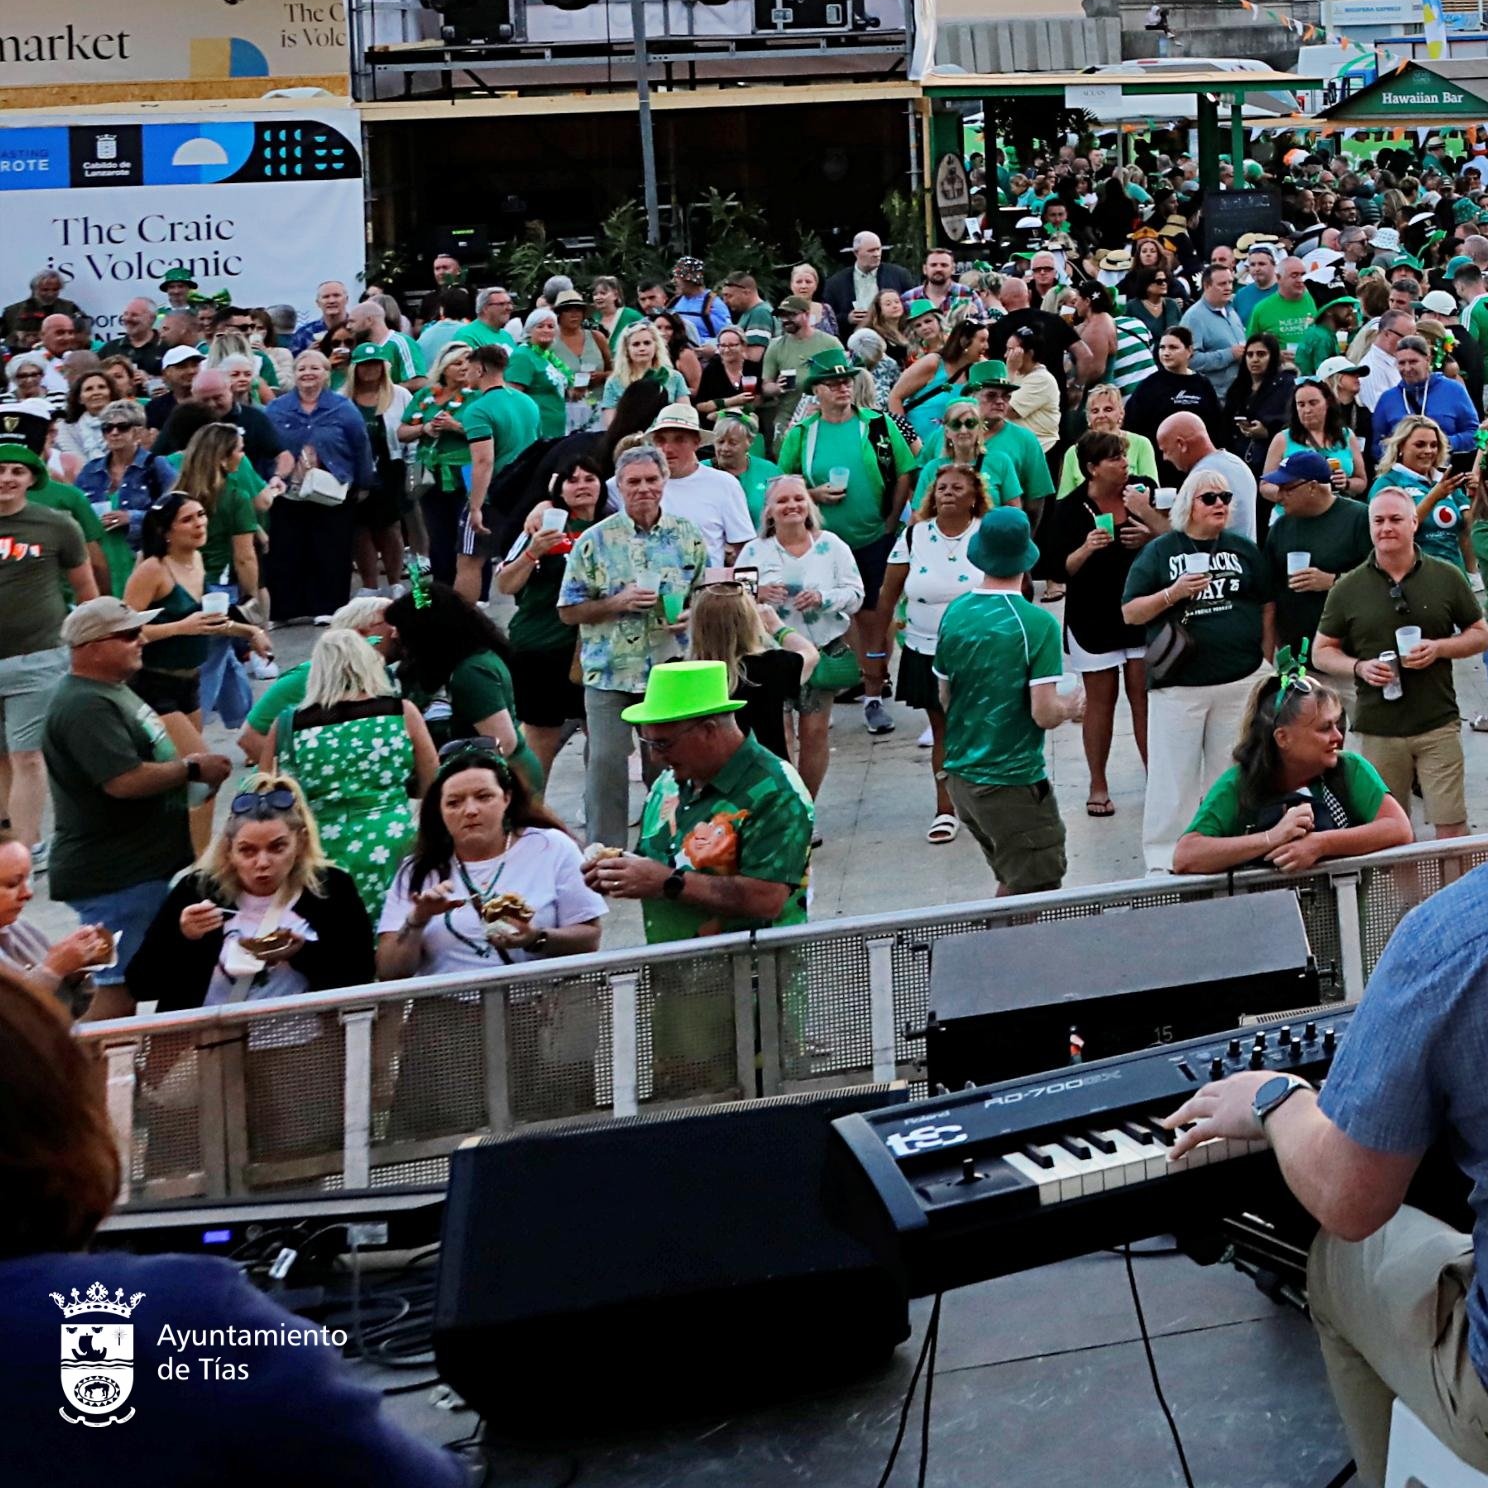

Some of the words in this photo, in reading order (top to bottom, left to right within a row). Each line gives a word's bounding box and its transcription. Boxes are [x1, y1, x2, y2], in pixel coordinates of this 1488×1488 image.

[1382, 92, 1439, 104] Hawaiian
[1443, 92, 1464, 104] Bar
[51, 217, 126, 247] The
[137, 213, 235, 244] Craic
[1154, 1025, 1173, 1044] 15
[903, 1109, 951, 1126] Roland
